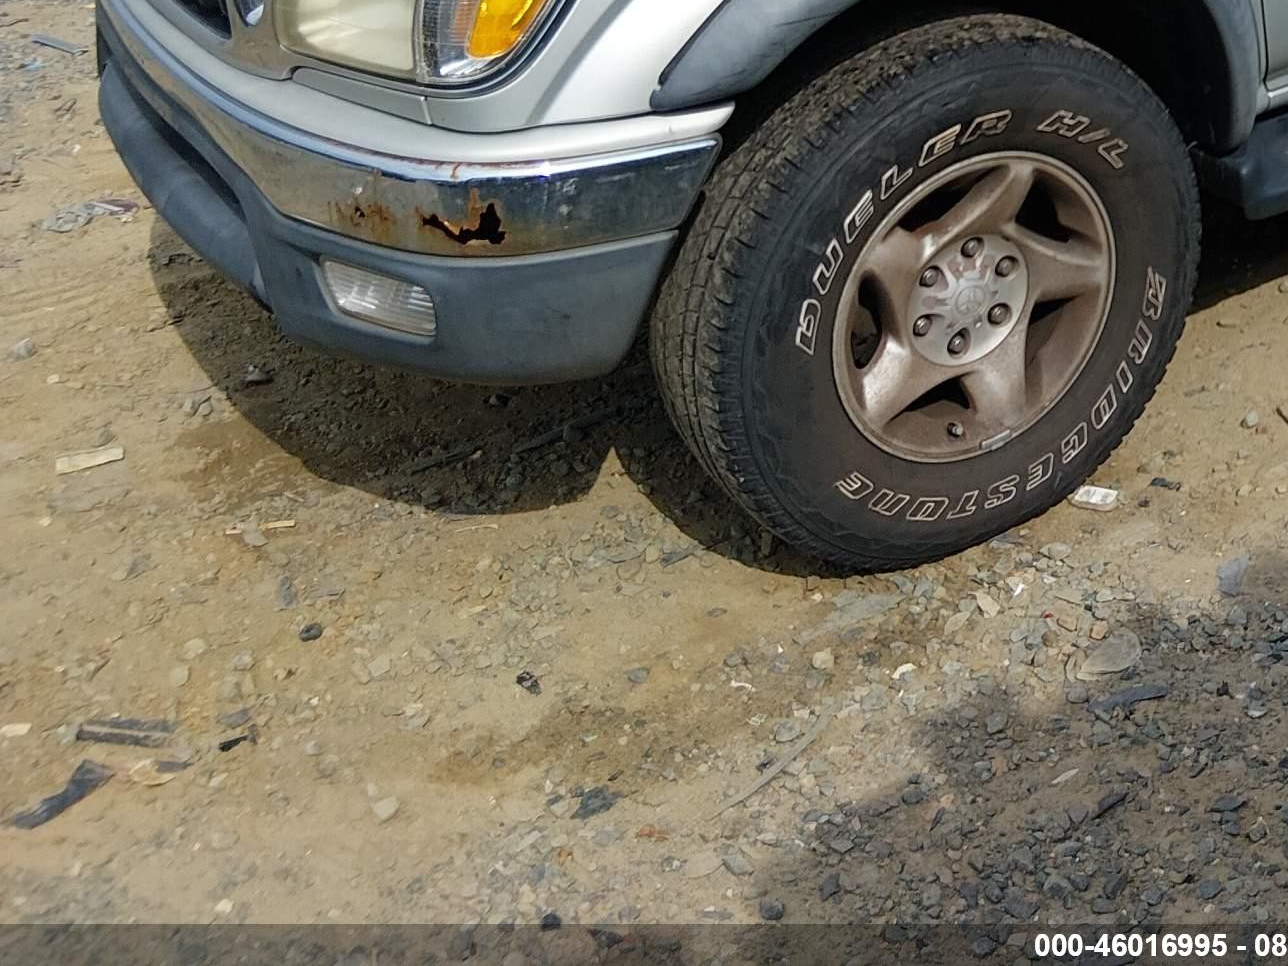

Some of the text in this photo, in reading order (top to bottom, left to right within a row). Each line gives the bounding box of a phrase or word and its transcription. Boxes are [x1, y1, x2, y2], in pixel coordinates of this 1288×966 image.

[794, 109, 1129, 356] DUELER H/L
[834, 266, 1169, 523] BRIDGESTONE
